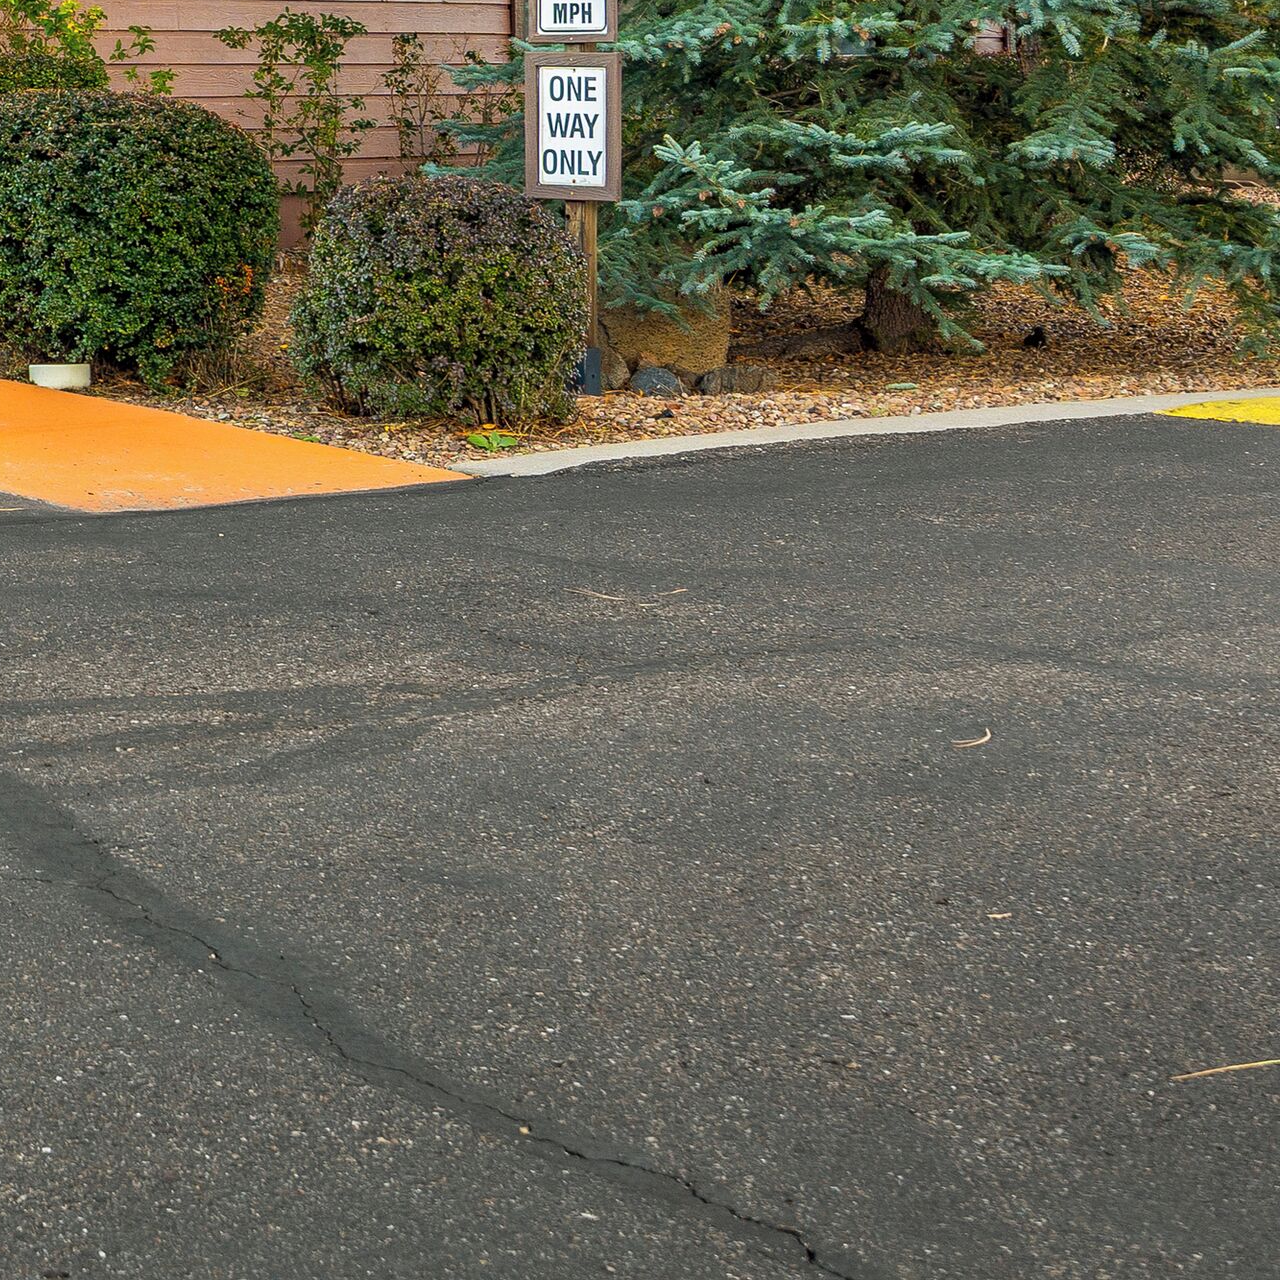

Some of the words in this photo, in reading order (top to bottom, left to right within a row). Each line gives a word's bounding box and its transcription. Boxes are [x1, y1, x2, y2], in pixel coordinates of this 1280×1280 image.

[552, 3, 592, 24] MPH
[549, 76, 597, 102] ONE
[547, 113, 599, 138] WAY
[542, 149, 603, 175] ONLY
